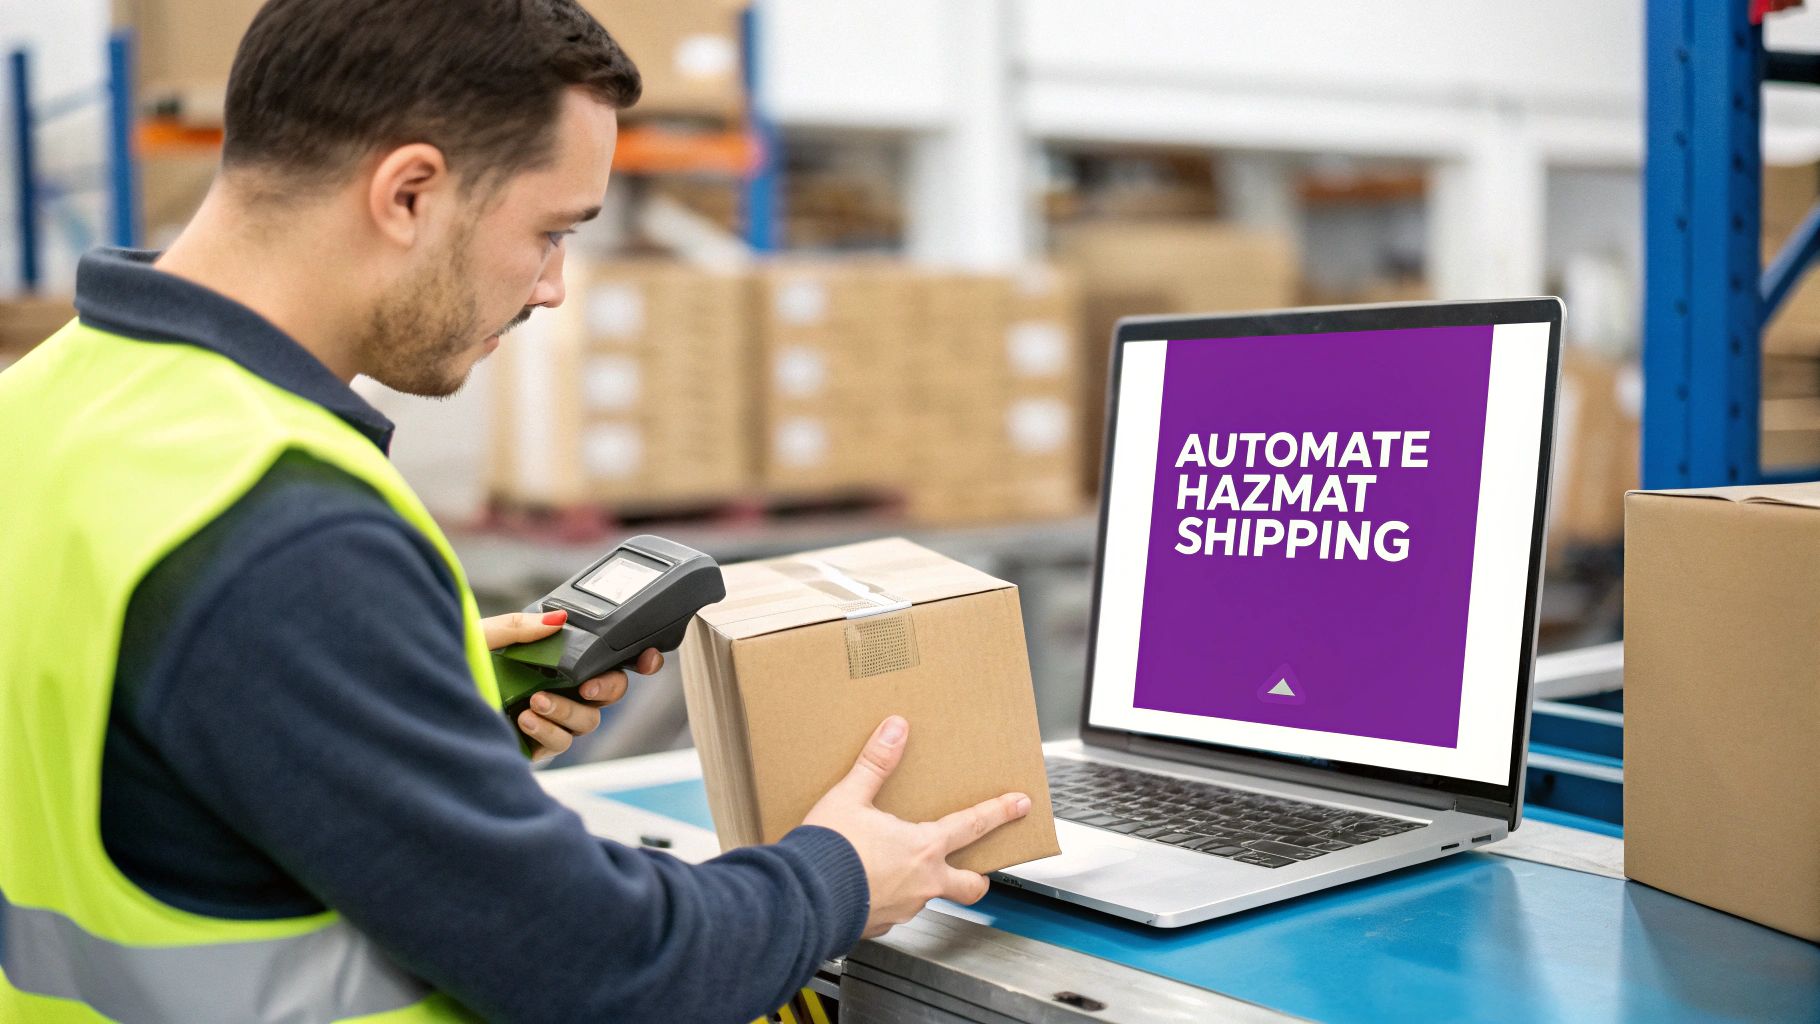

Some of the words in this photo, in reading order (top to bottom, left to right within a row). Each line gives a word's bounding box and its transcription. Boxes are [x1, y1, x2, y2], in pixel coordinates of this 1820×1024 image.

[1174, 430, 1431, 468] AUTOMATE
[1176, 474, 1378, 513] HAZMAT
[1174, 516, 1411, 562] SHIPPING
